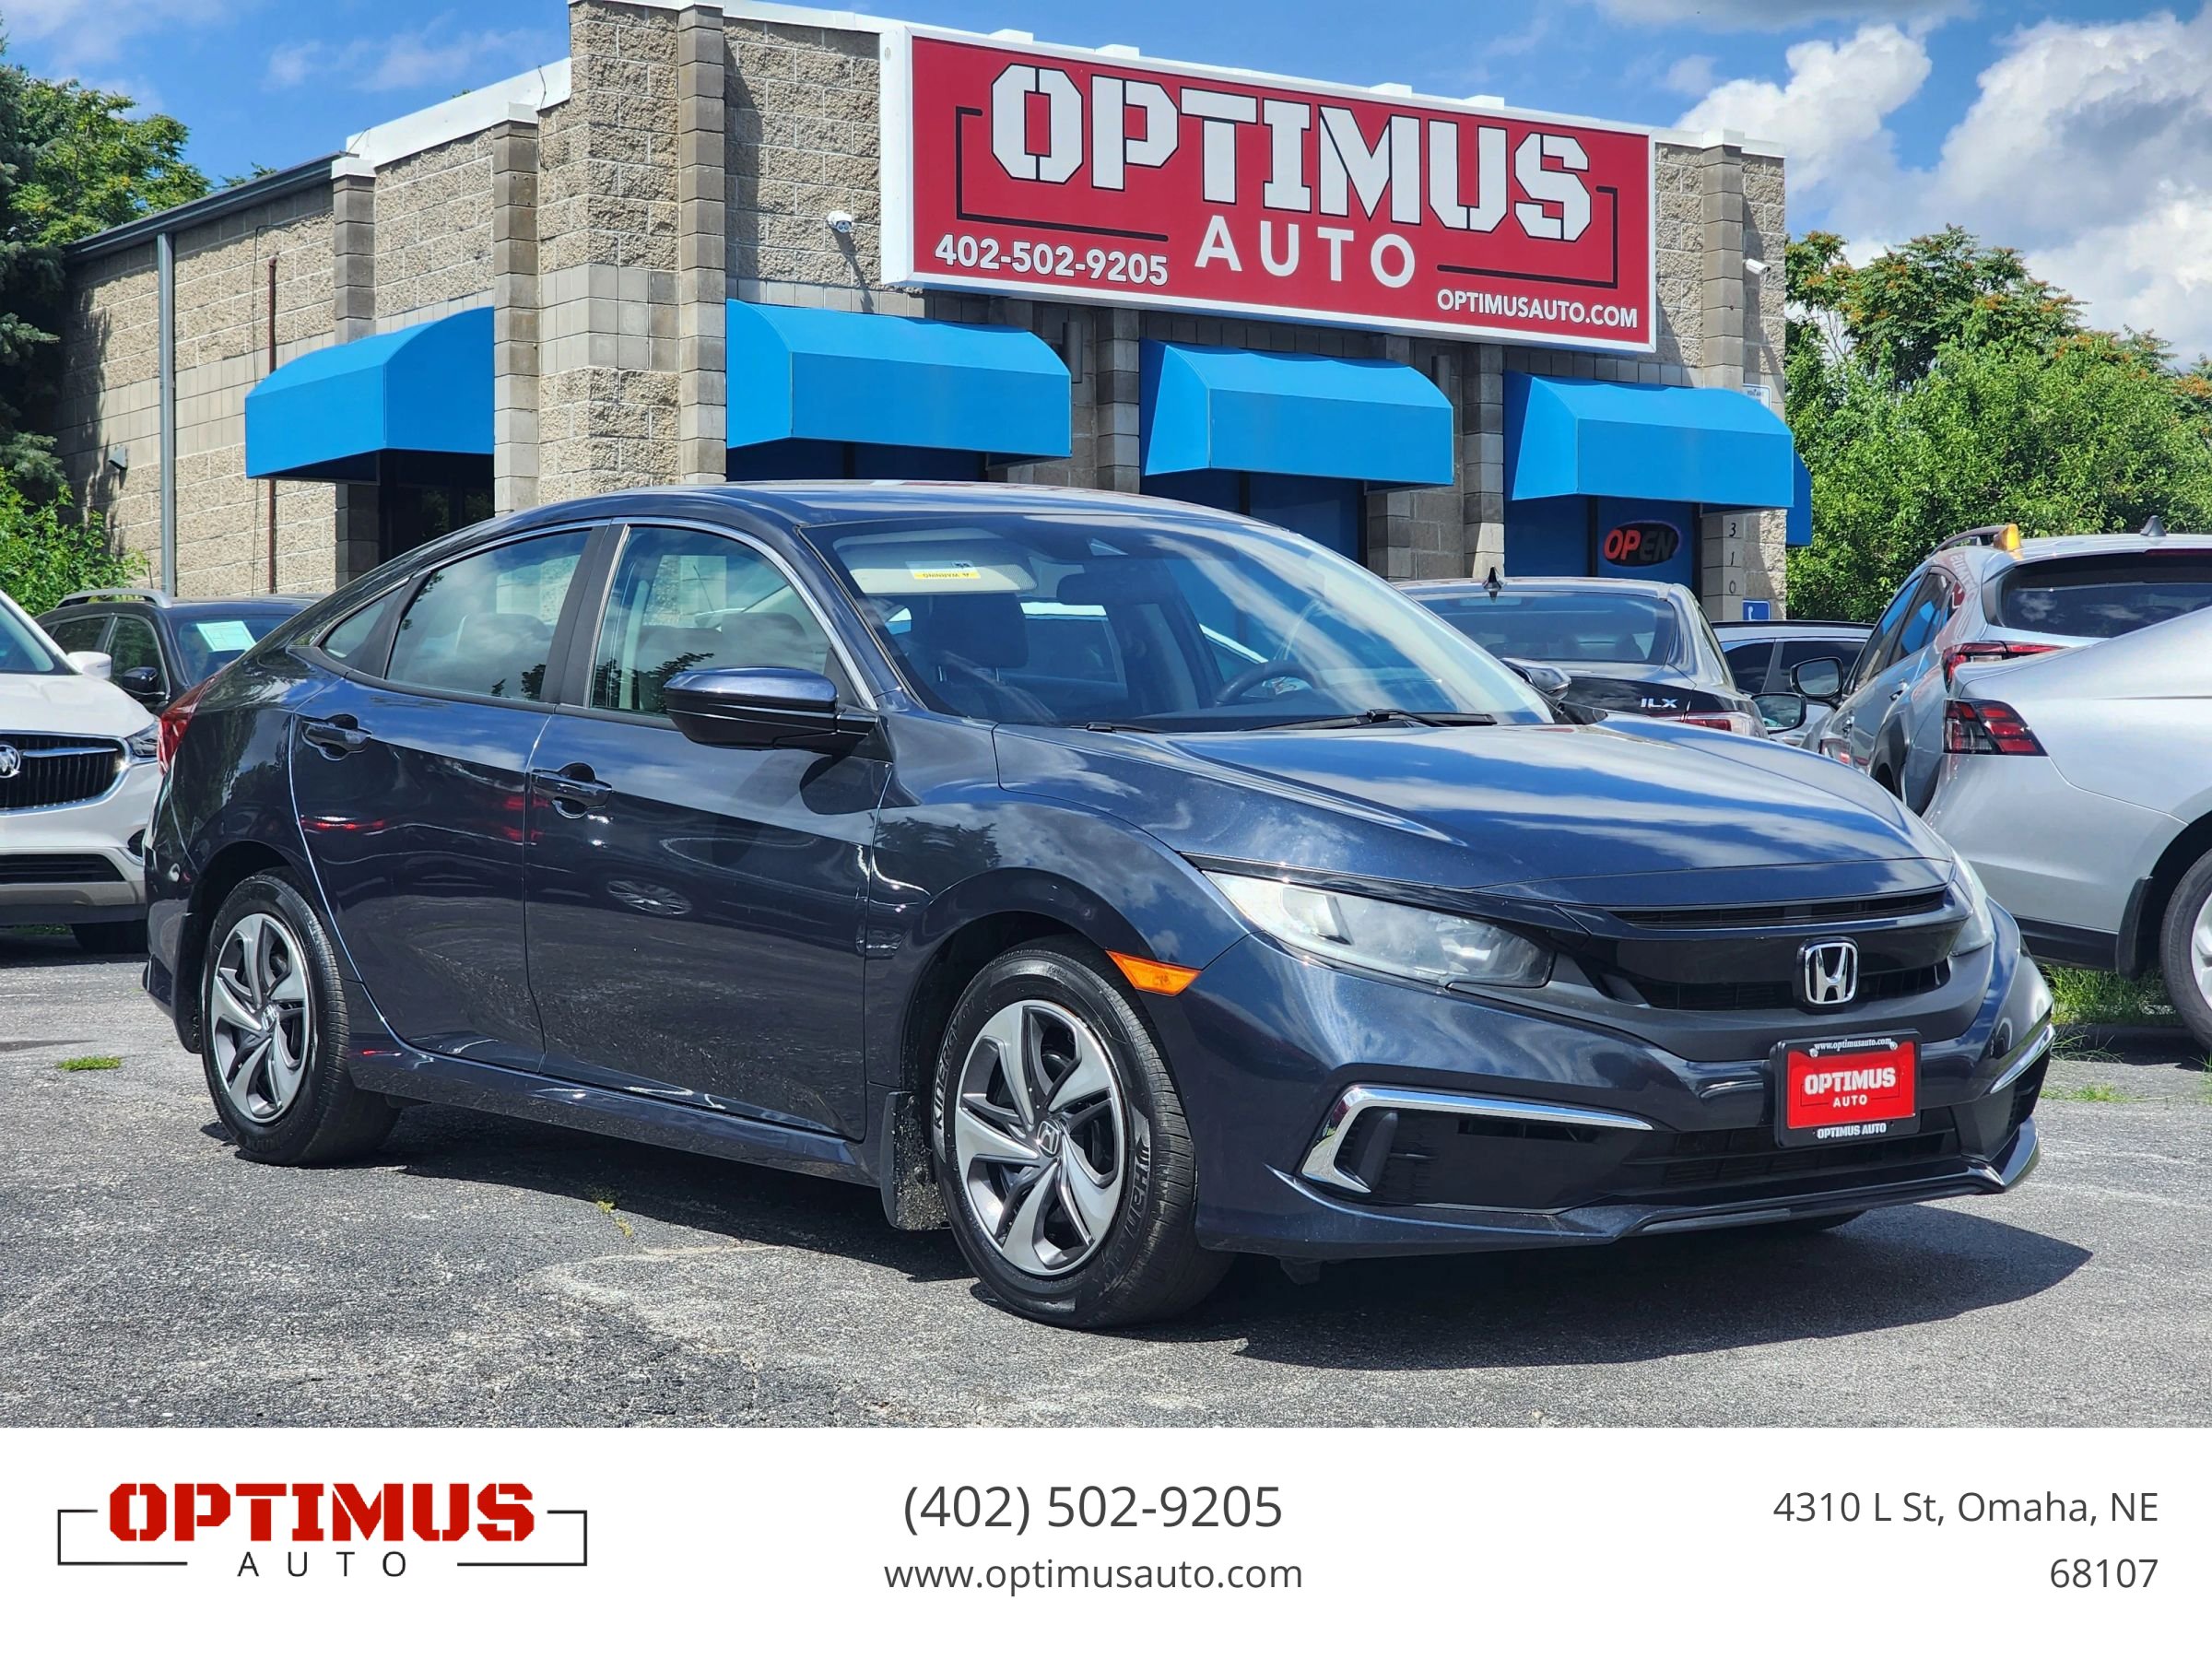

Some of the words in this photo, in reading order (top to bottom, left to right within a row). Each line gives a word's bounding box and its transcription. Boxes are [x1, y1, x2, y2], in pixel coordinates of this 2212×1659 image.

[991, 63, 1593, 242] OPTIMUS
[935, 233, 1170, 287] 402-502-9205
[1194, 215, 1417, 288] AUTO
[1436, 288, 1639, 330] OPTIMUSAUTO.COM
[1604, 529, 1676, 561] OPEN
[1640, 697, 1678, 710] ILX
[1814, 1038, 1892, 1052] www.optimusauto.com
[1804, 1066, 1897, 1096] OPTIMUS
[1833, 1095, 1868, 1108] AUTO
[1817, 1124, 1861, 1139] OPTIMUS
[1862, 1123, 1887, 1135] AUTO
